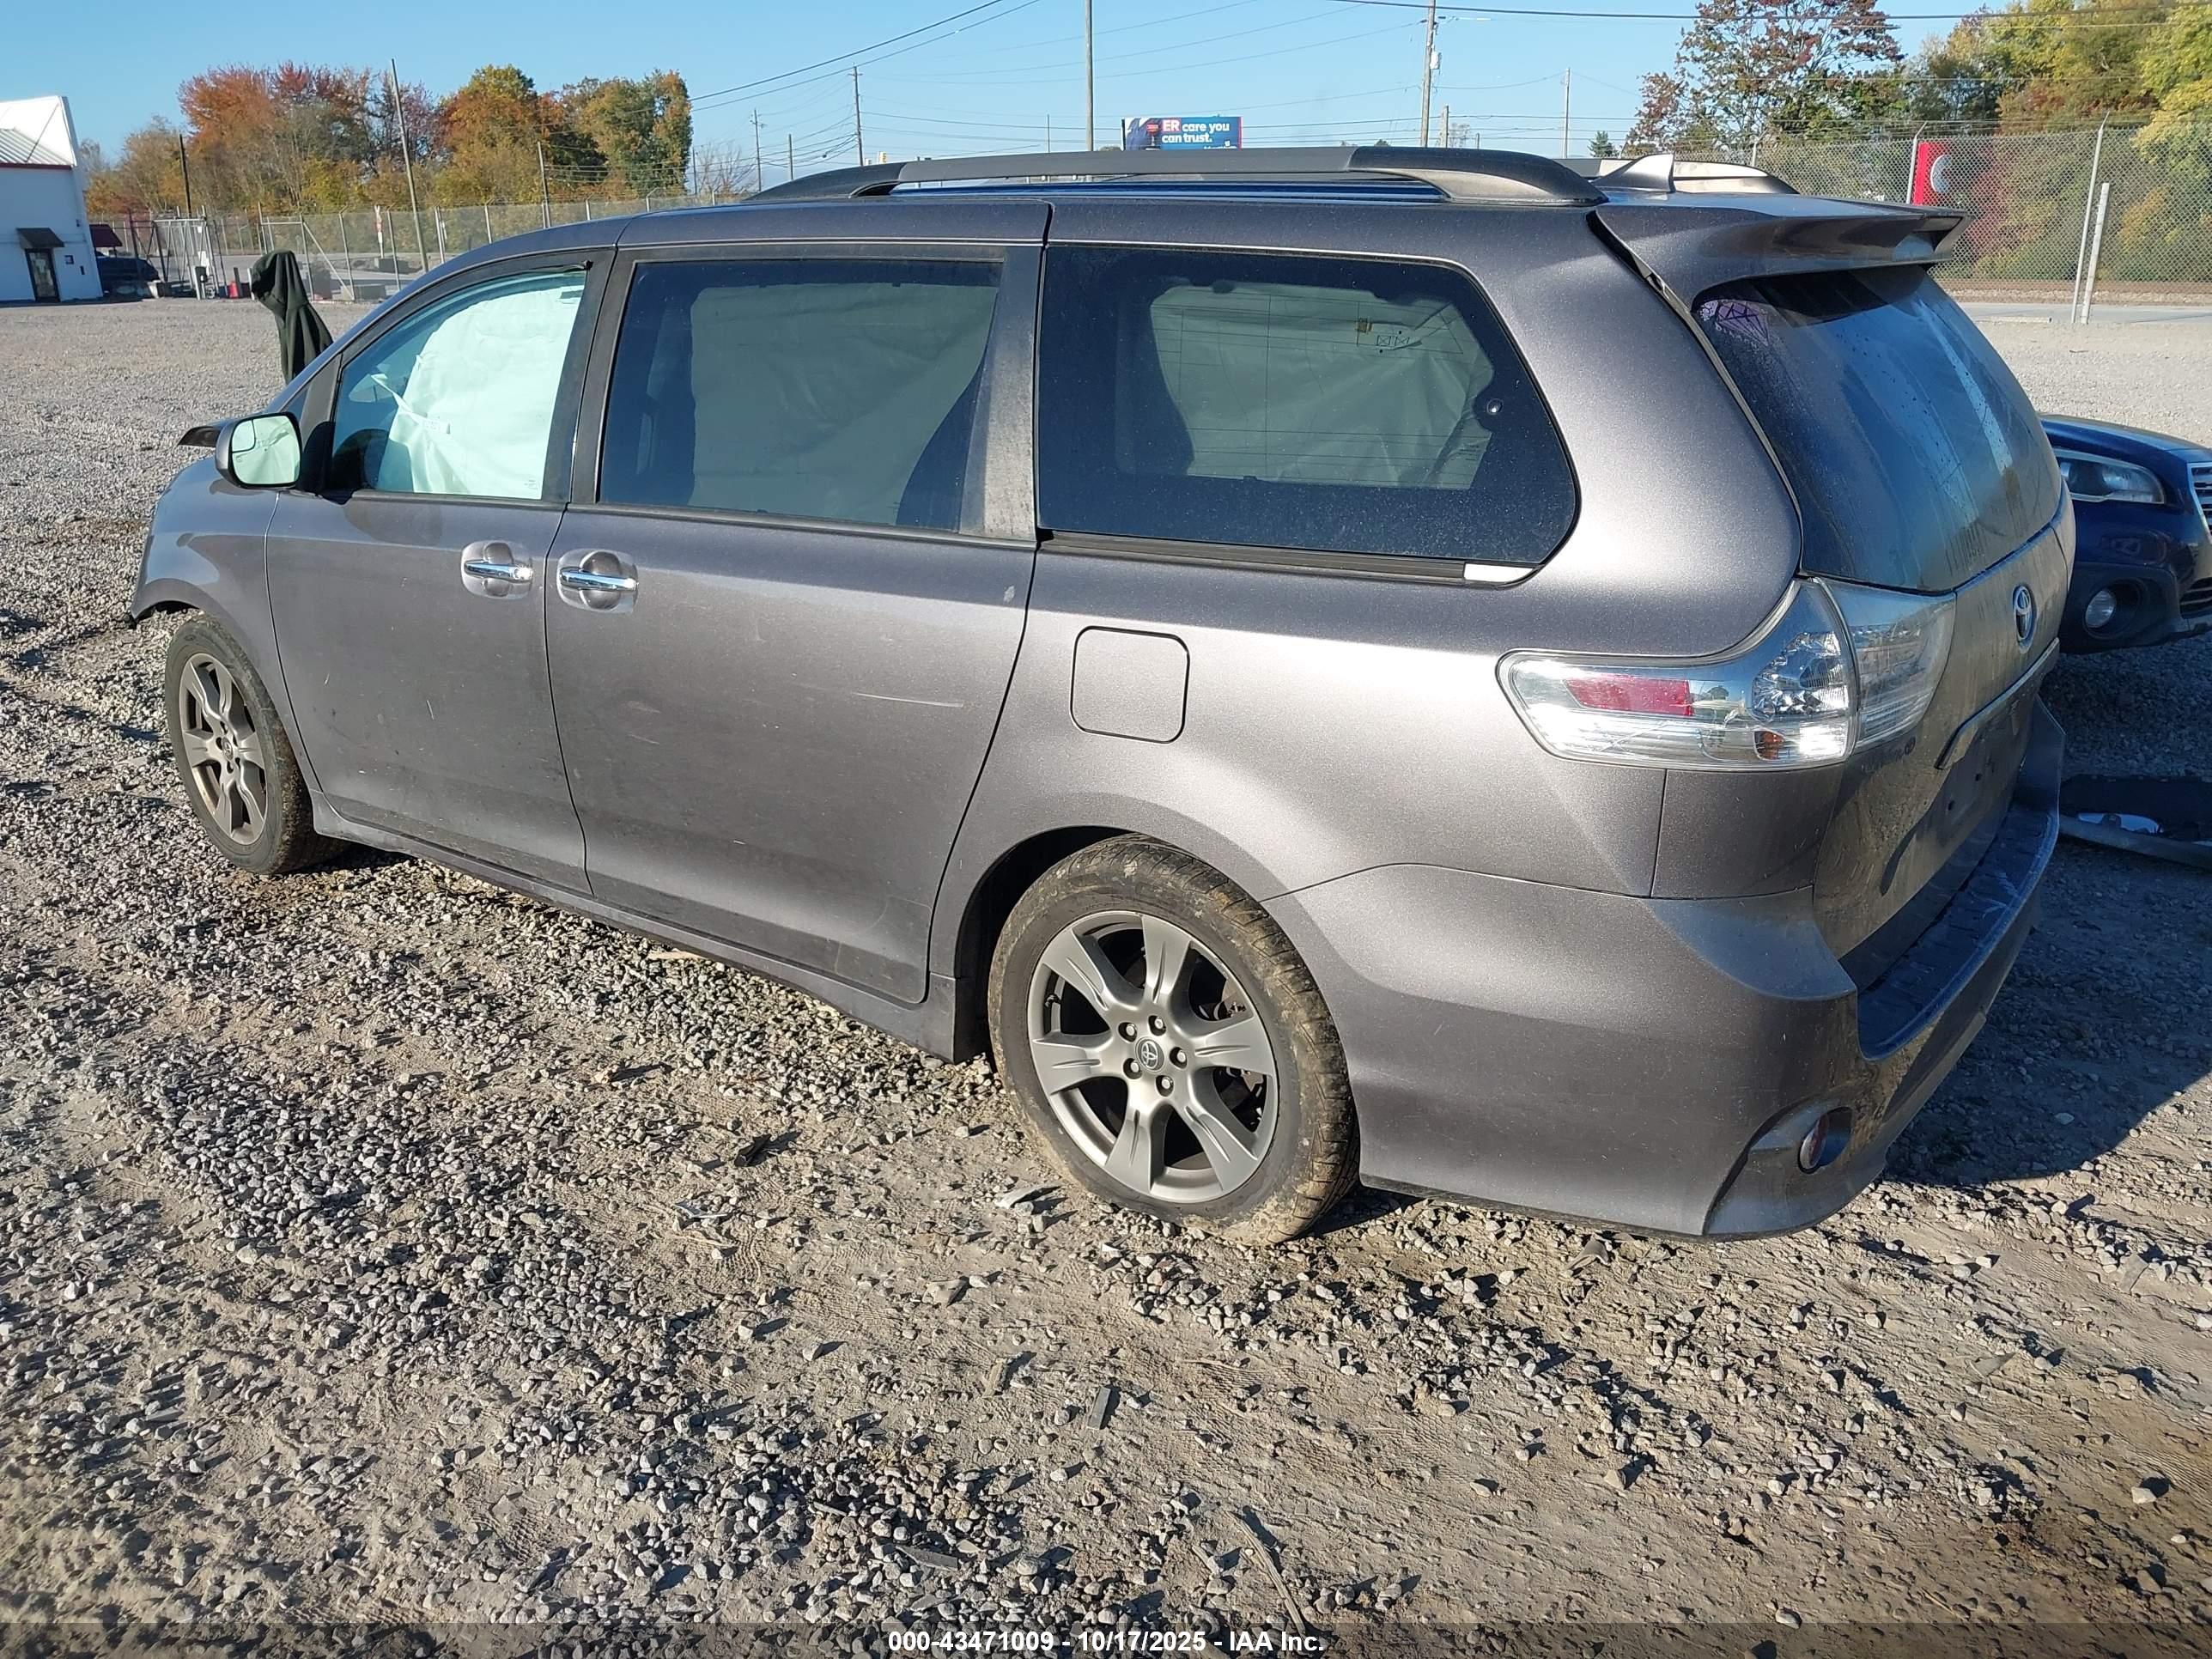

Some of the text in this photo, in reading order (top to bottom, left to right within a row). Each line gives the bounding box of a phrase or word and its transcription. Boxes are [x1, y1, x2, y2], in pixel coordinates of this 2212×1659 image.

[1162, 119, 1181, 131] ER
[1182, 123, 1206, 132] care
[1208, 123, 1230, 133] you
[1161, 133, 1212, 143] can trust.
